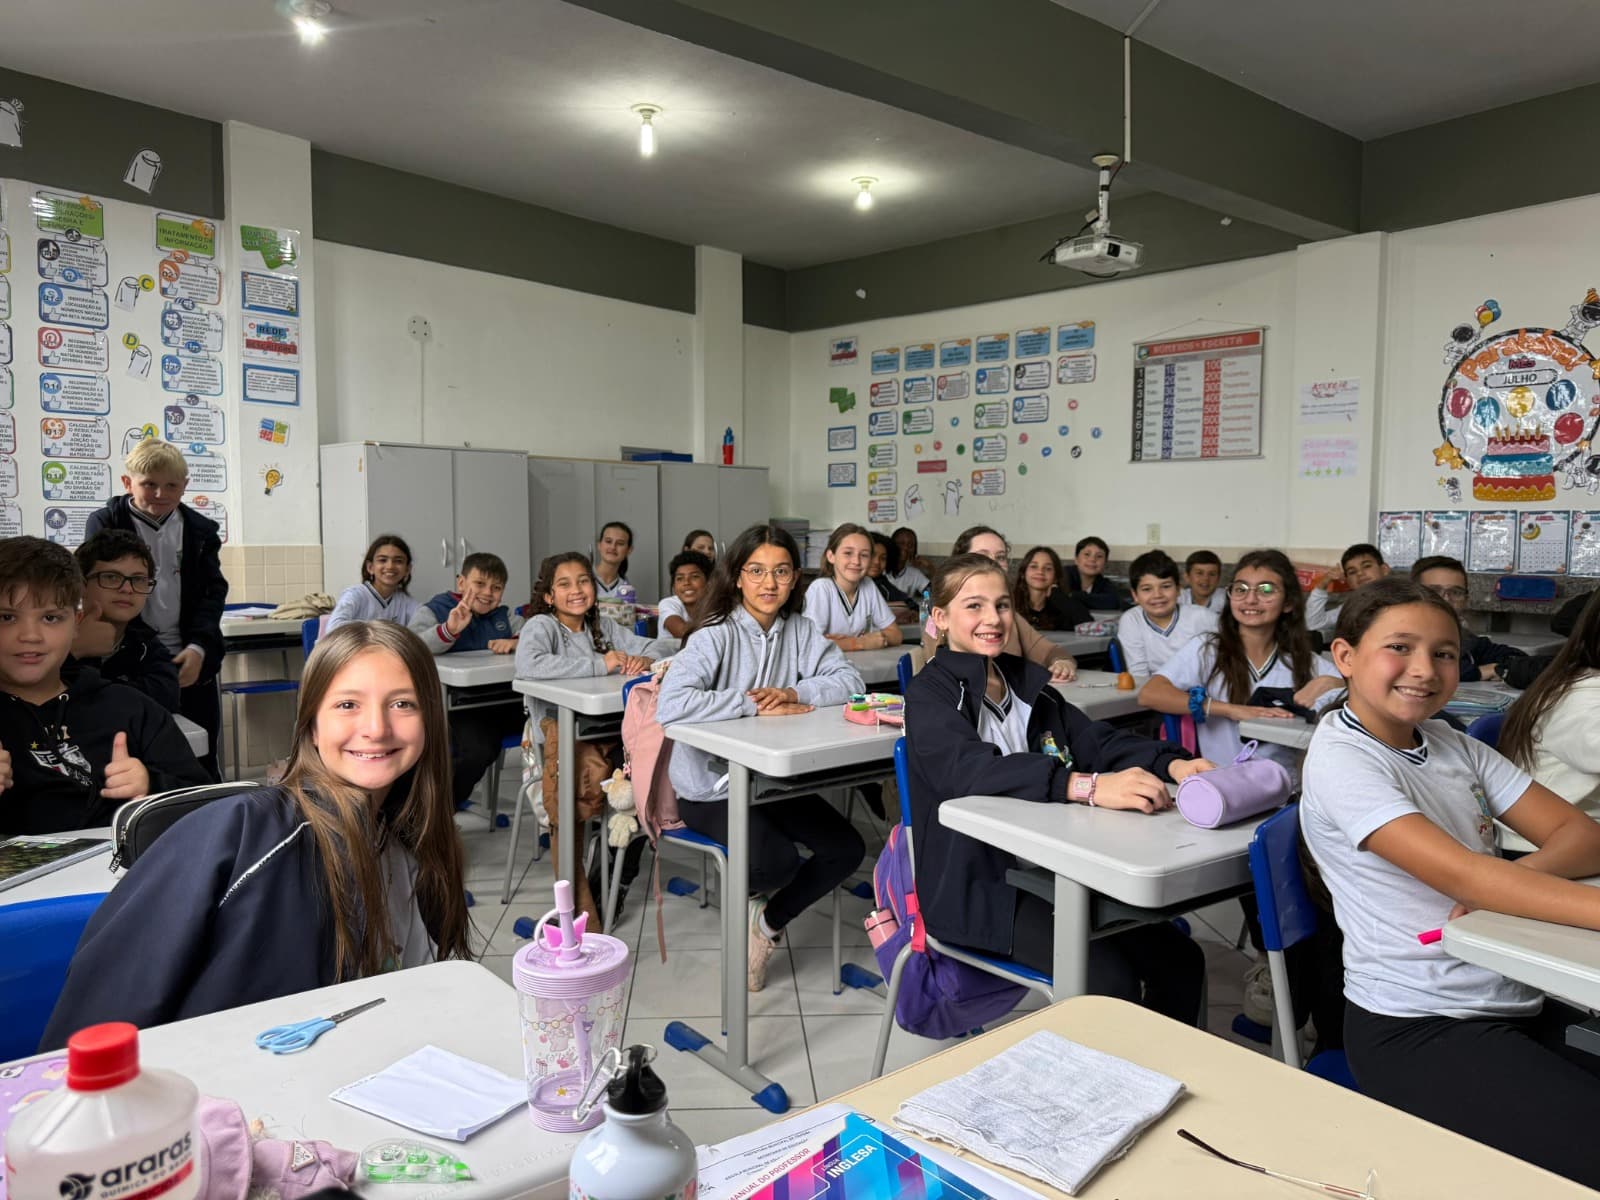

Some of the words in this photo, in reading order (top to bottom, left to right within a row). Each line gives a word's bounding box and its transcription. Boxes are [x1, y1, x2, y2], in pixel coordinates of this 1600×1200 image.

[142, 278, 151, 290] C
[126, 333, 137, 346] D
[1206, 361, 1221, 370] 100
[1137, 380, 1143, 388] 2
[1206, 372, 1221, 381] 200
[1503, 374, 1538, 384] JULHO
[144, 426, 154, 437] A
[101, 1131, 192, 1188] araras
[826, 1144, 878, 1179] INGLESA
[758, 1174, 770, 1185] DO
[769, 1148, 811, 1178] PROFESSOR
